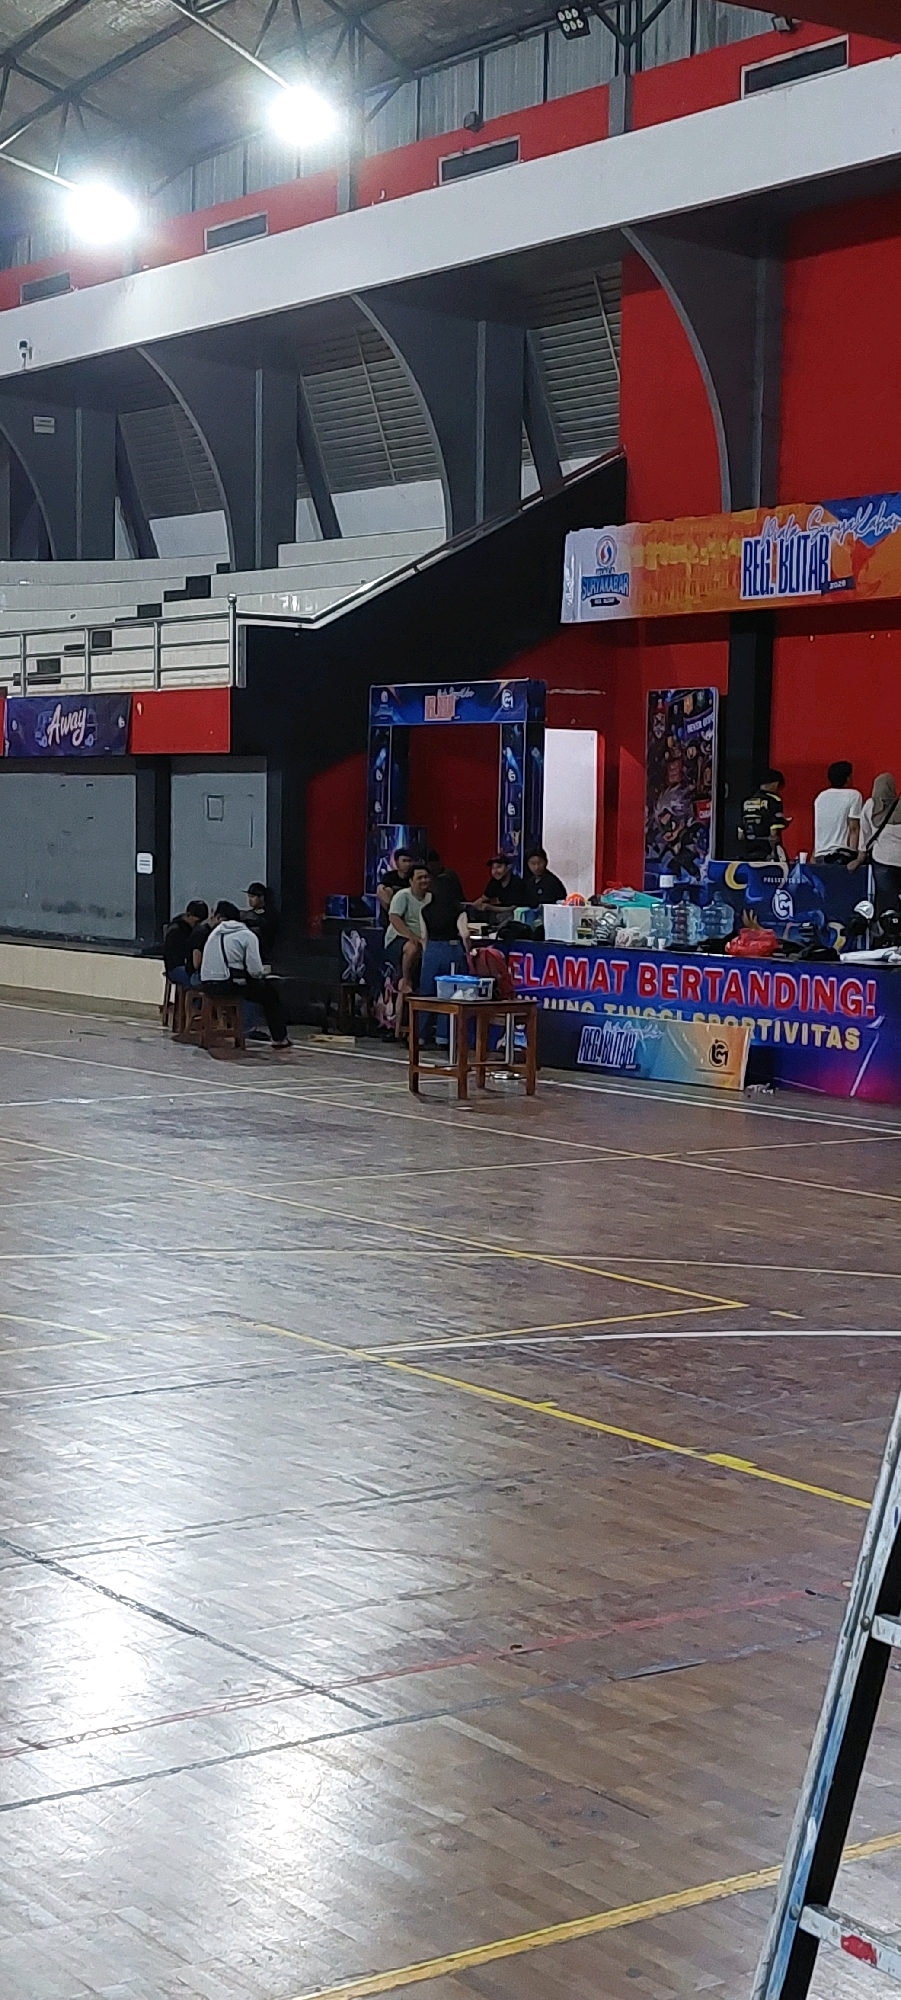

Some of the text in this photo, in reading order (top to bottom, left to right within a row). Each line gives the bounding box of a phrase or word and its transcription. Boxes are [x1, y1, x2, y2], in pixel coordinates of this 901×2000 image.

[742, 538, 775, 597] REG.
[46, 703, 87, 747] Away
[507, 950, 877, 1018] ELAMAT BERTANDING!
